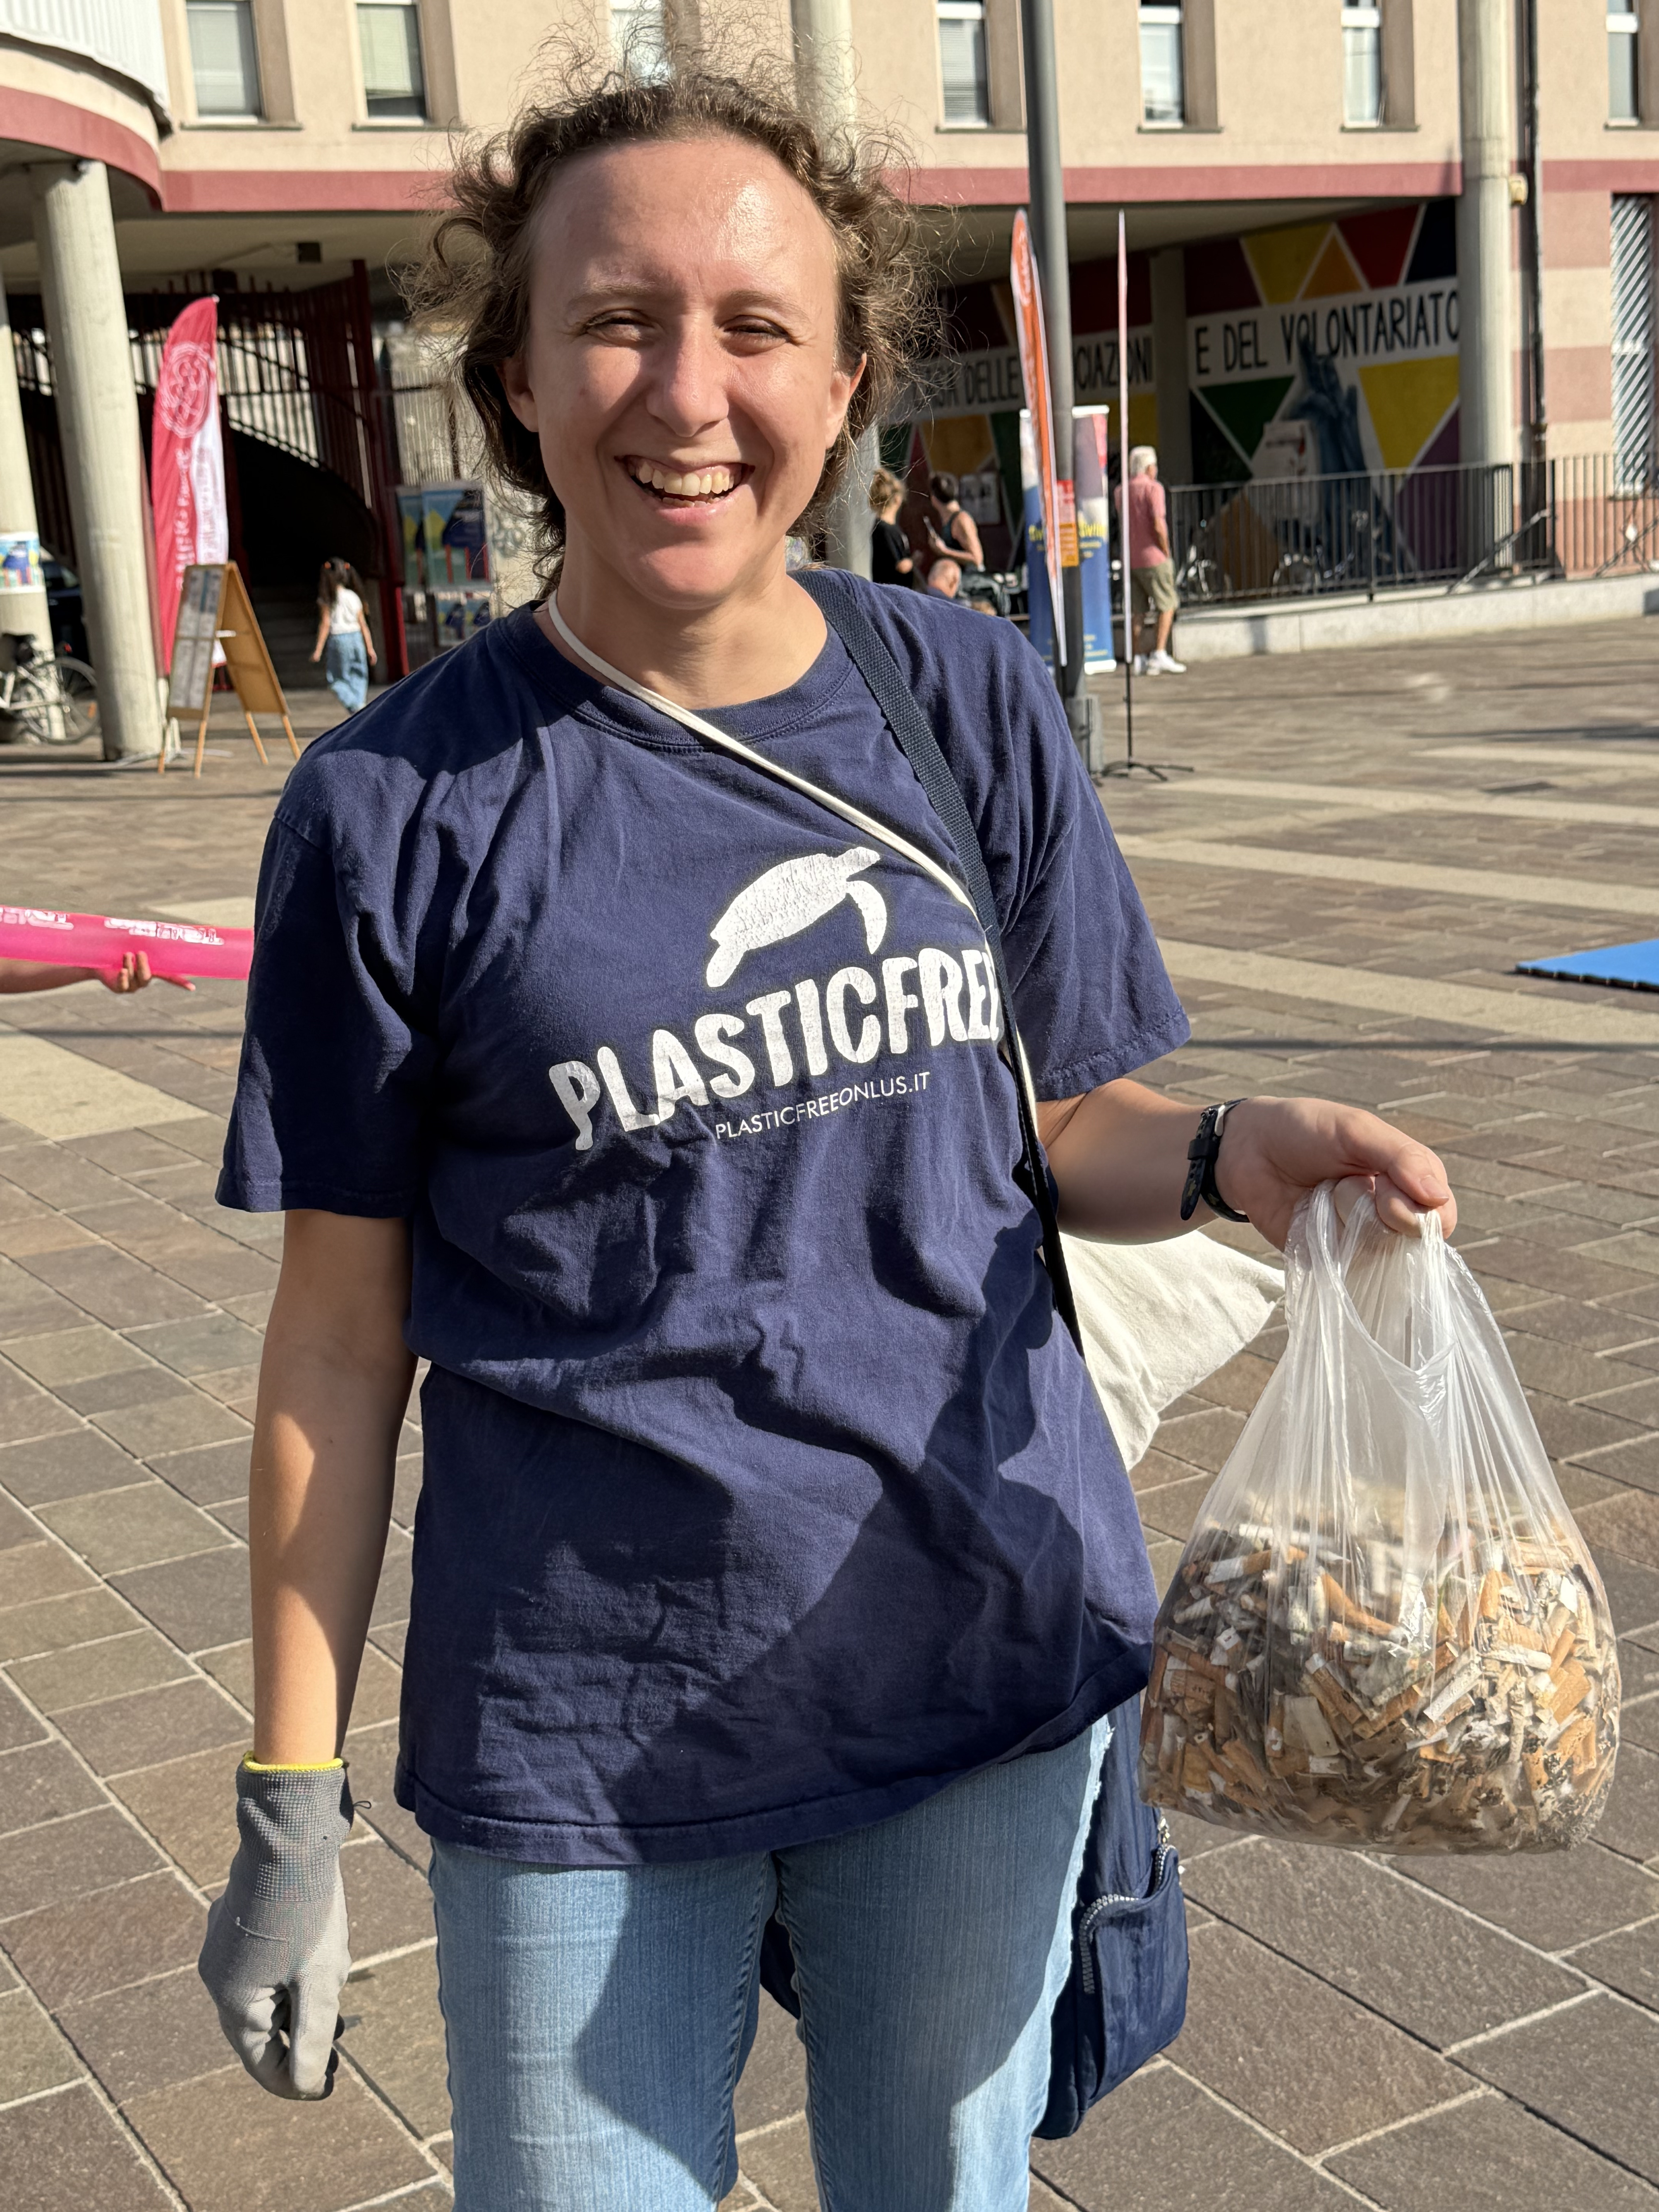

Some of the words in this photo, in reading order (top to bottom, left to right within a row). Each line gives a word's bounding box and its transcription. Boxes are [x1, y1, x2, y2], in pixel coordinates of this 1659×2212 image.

[965, 356, 1018, 404] DELLE
[1195, 326, 1210, 374] E
[1224, 320, 1268, 372] DEL
[1281, 292, 1460, 362] VOLONTARIATO
[715, 1072, 931, 1140] PLASTICFREEONLUS.IT
